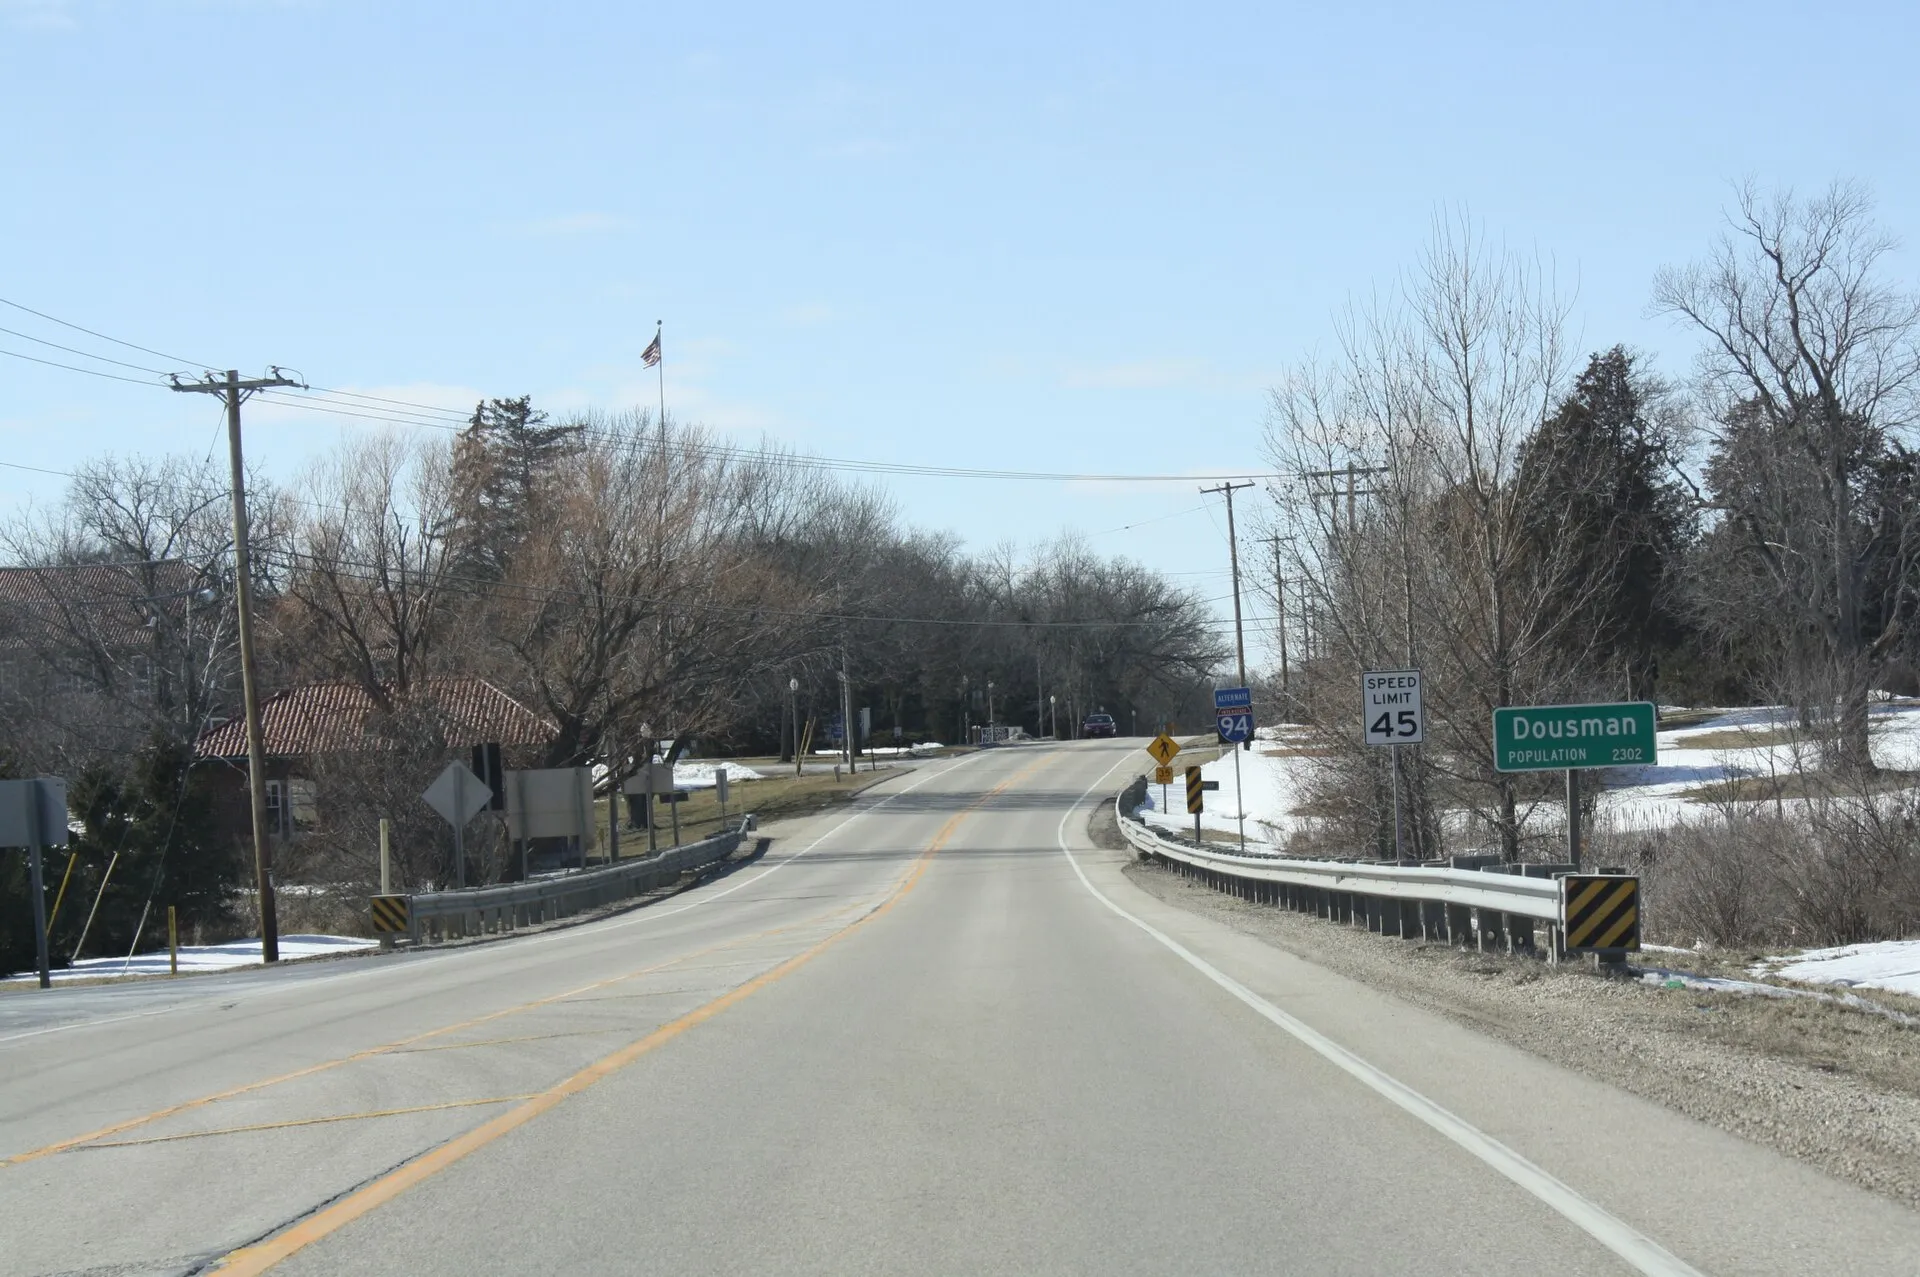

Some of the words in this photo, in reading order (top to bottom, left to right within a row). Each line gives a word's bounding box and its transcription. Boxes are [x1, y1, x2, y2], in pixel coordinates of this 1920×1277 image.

[1367, 677, 1417, 689] SPEED
[1373, 692, 1412, 705] LIMIT
[1220, 715, 1249, 736] 94
[1370, 710, 1418, 738] 45
[1513, 716, 1637, 740] Dousman
[1508, 748, 1587, 763] POPULATION
[1612, 747, 1642, 762] 2302
